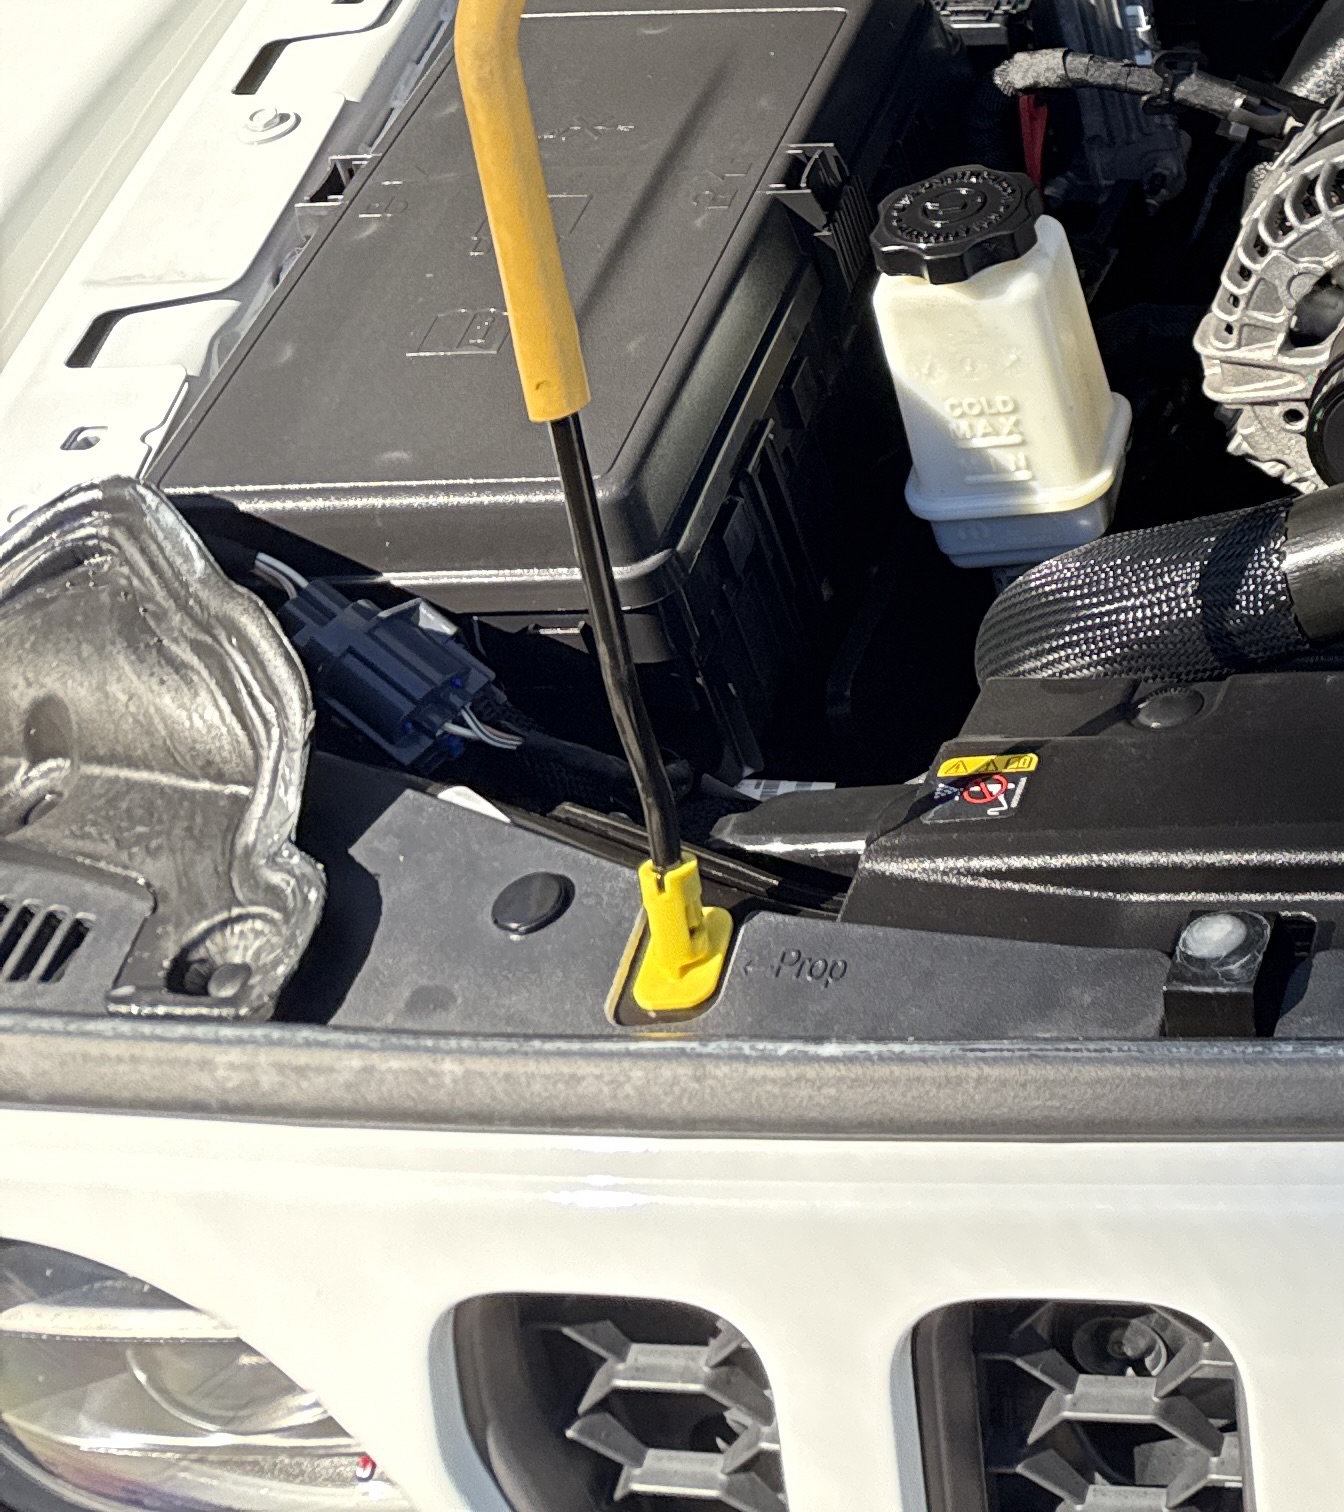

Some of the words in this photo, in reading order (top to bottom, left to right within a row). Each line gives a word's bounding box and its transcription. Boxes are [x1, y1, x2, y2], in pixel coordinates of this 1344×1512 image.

[944, 395, 1015, 418] COLD
[949, 417, 1022, 438] MAX
[775, 949, 848, 988] Prop
